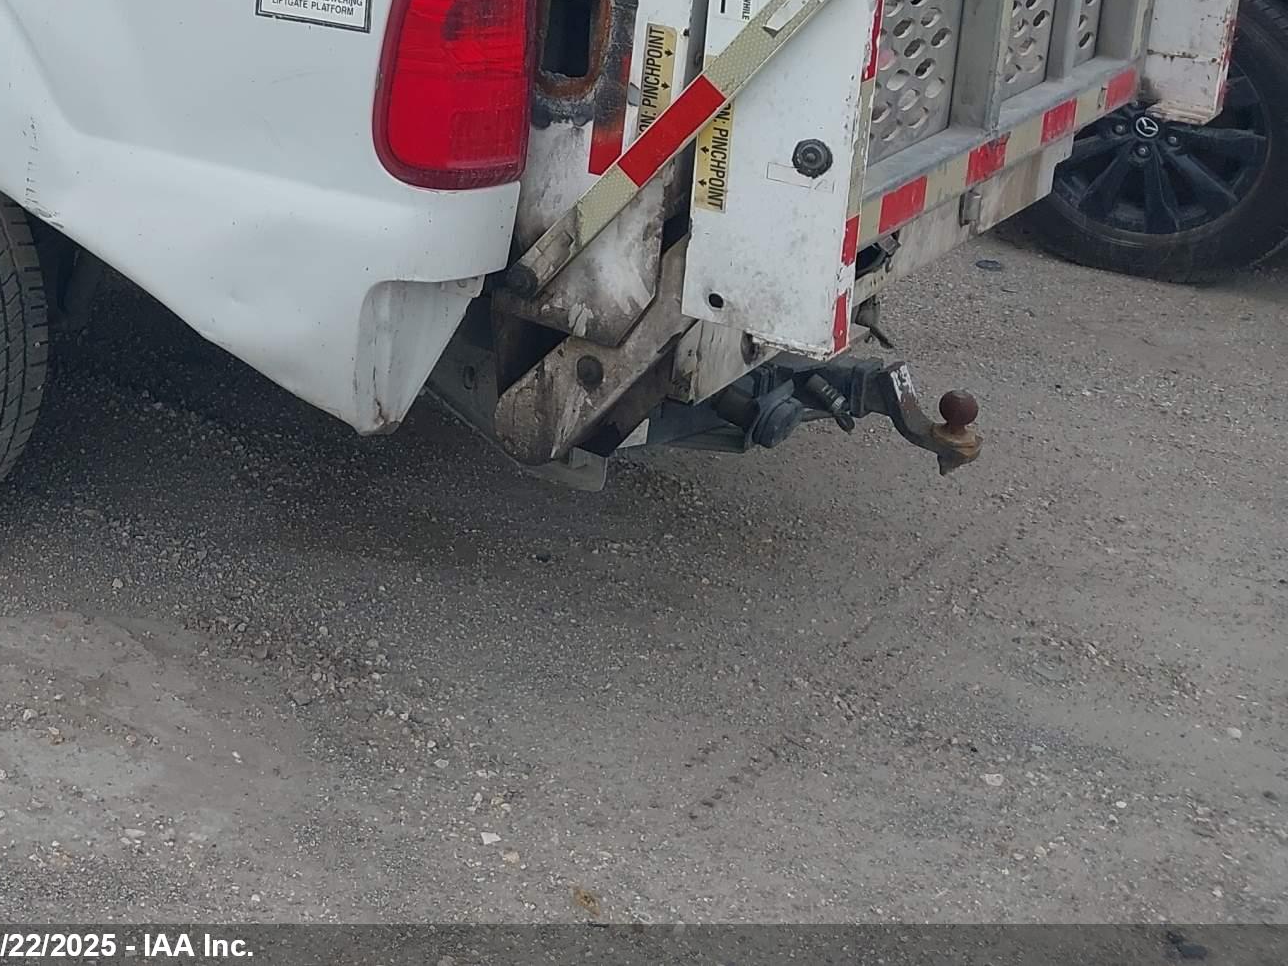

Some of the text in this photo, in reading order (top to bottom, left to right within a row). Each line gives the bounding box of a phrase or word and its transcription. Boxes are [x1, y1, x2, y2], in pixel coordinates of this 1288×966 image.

[310, 1, 354, 16] PLATFORM
[641, 26, 665, 109] PINCHPOINT
[707, 126, 730, 211] PINCHPOINT
